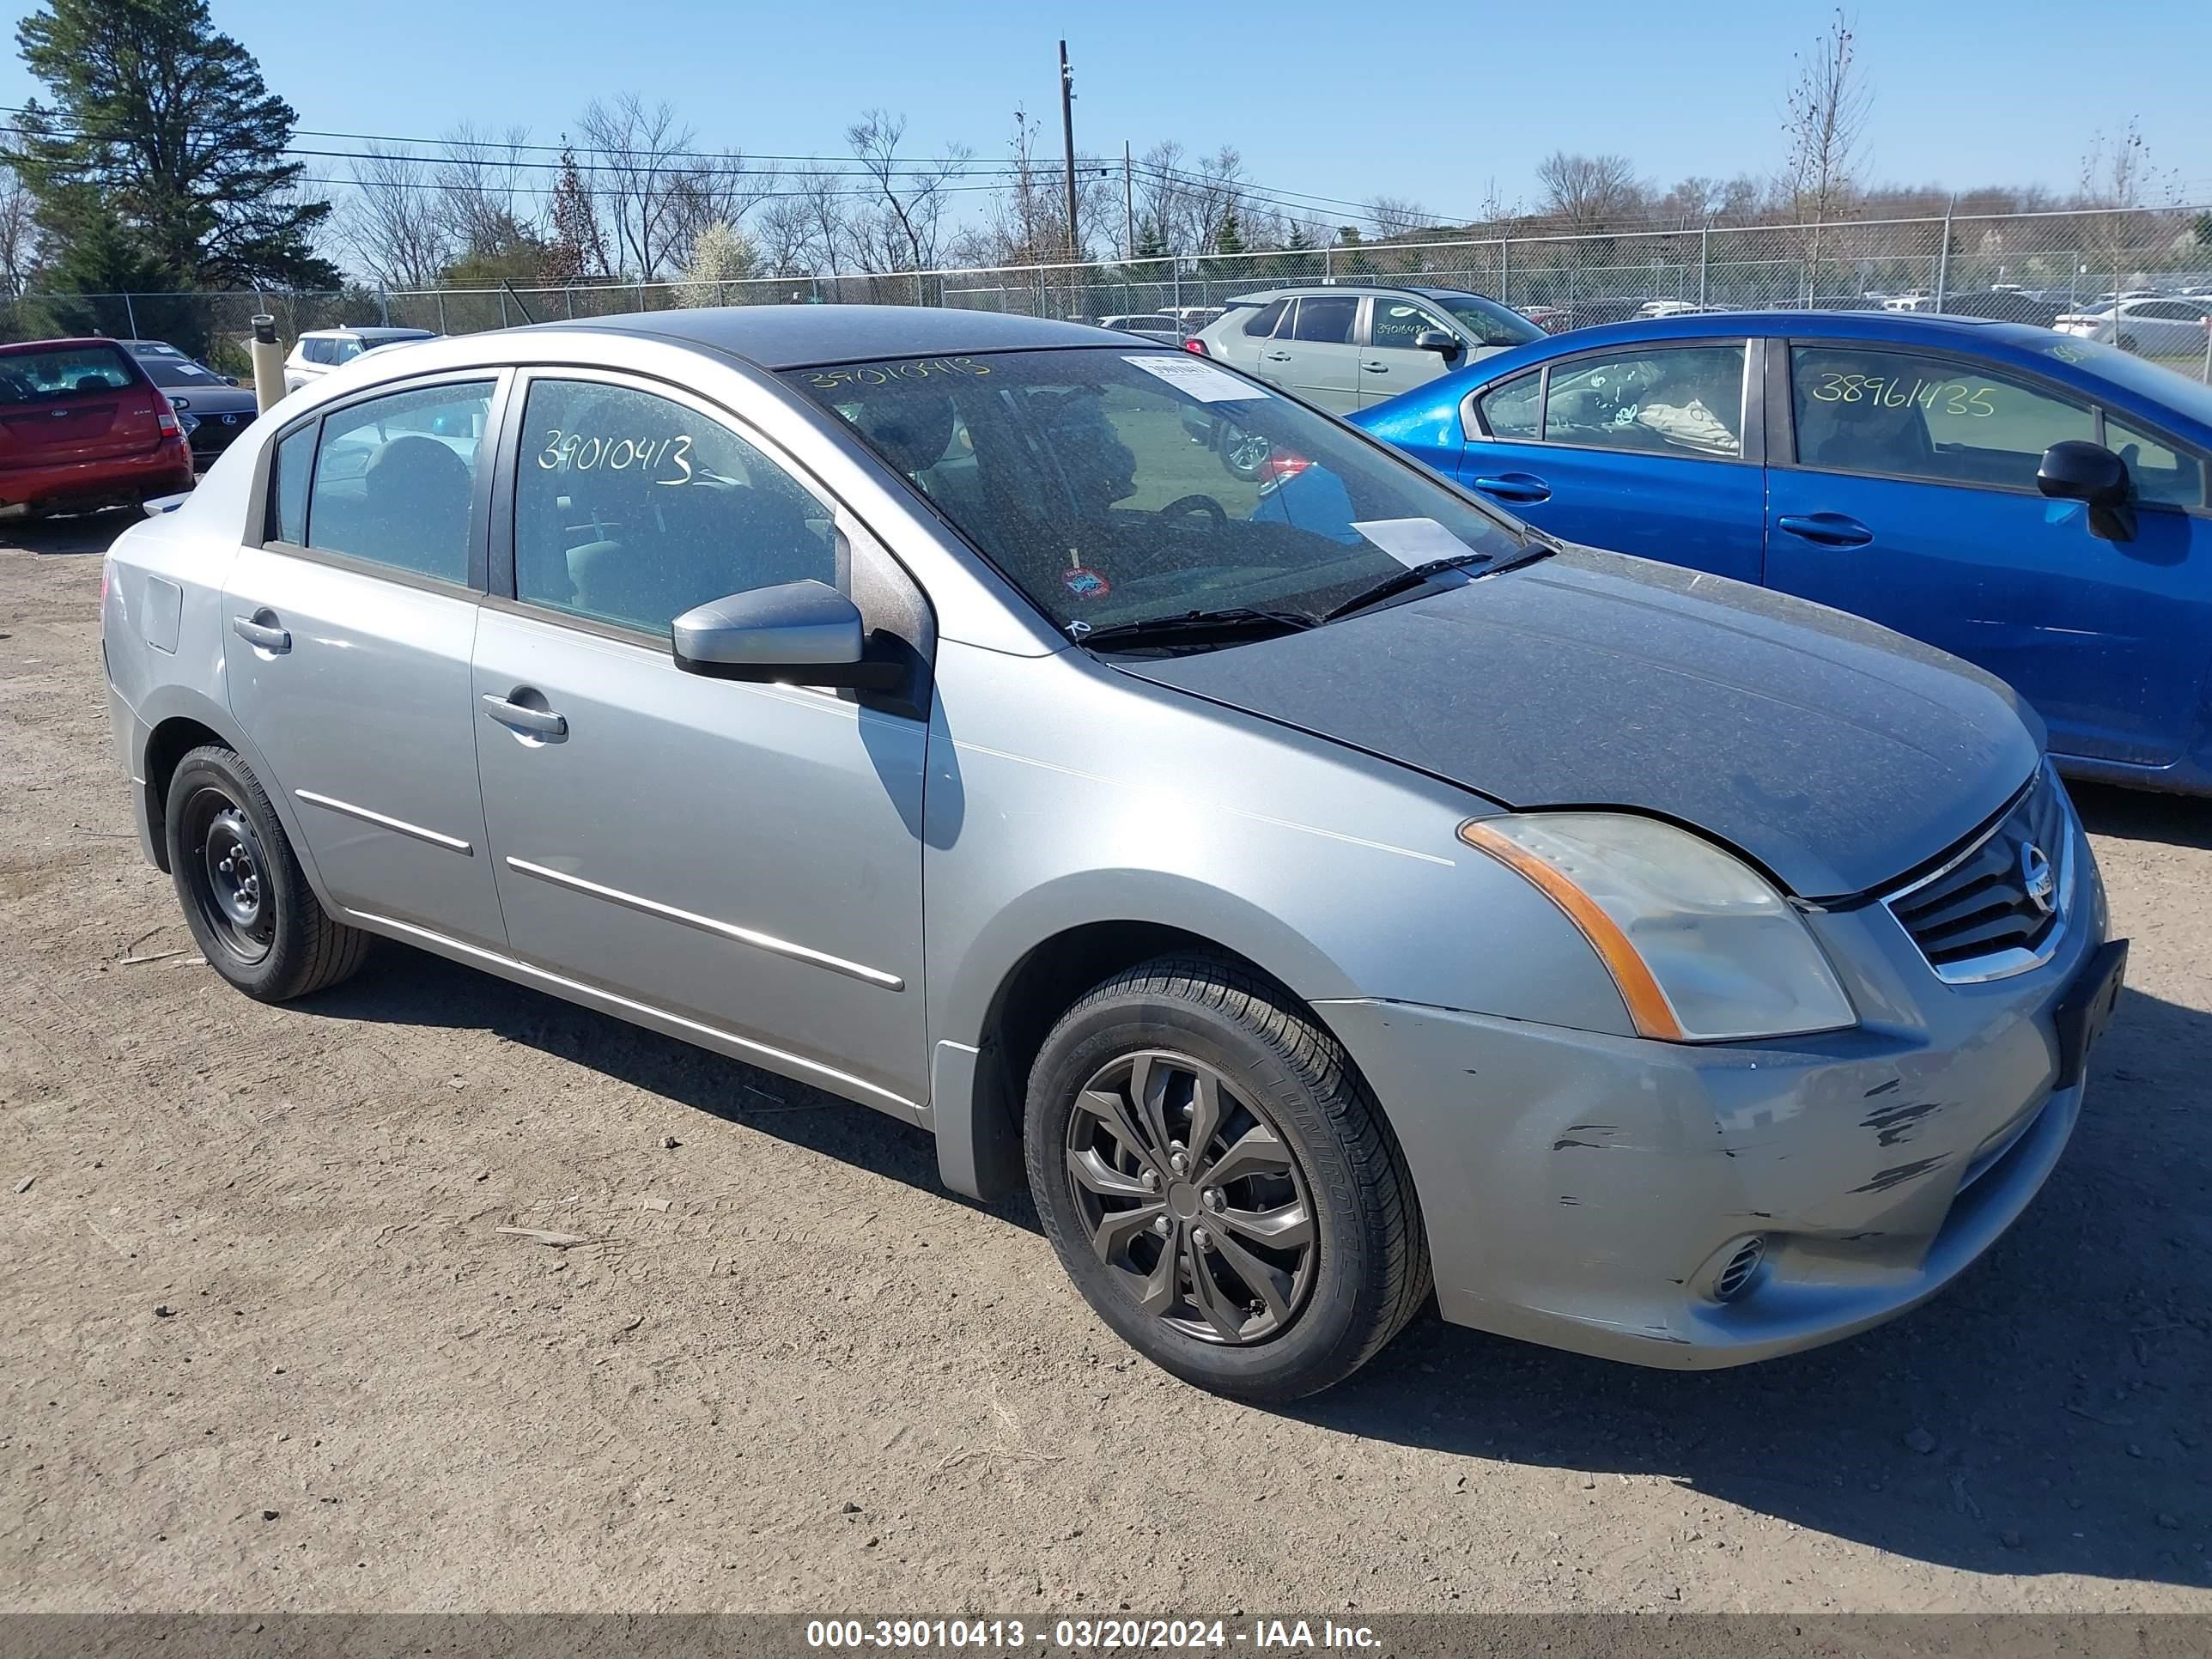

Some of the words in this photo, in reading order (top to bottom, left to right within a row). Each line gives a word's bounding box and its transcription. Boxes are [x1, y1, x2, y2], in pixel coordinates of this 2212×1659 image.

[801, 356, 991, 389] 39010413
[1813, 373, 1997, 417] 38961435
[538, 429, 693, 486] 39010413
